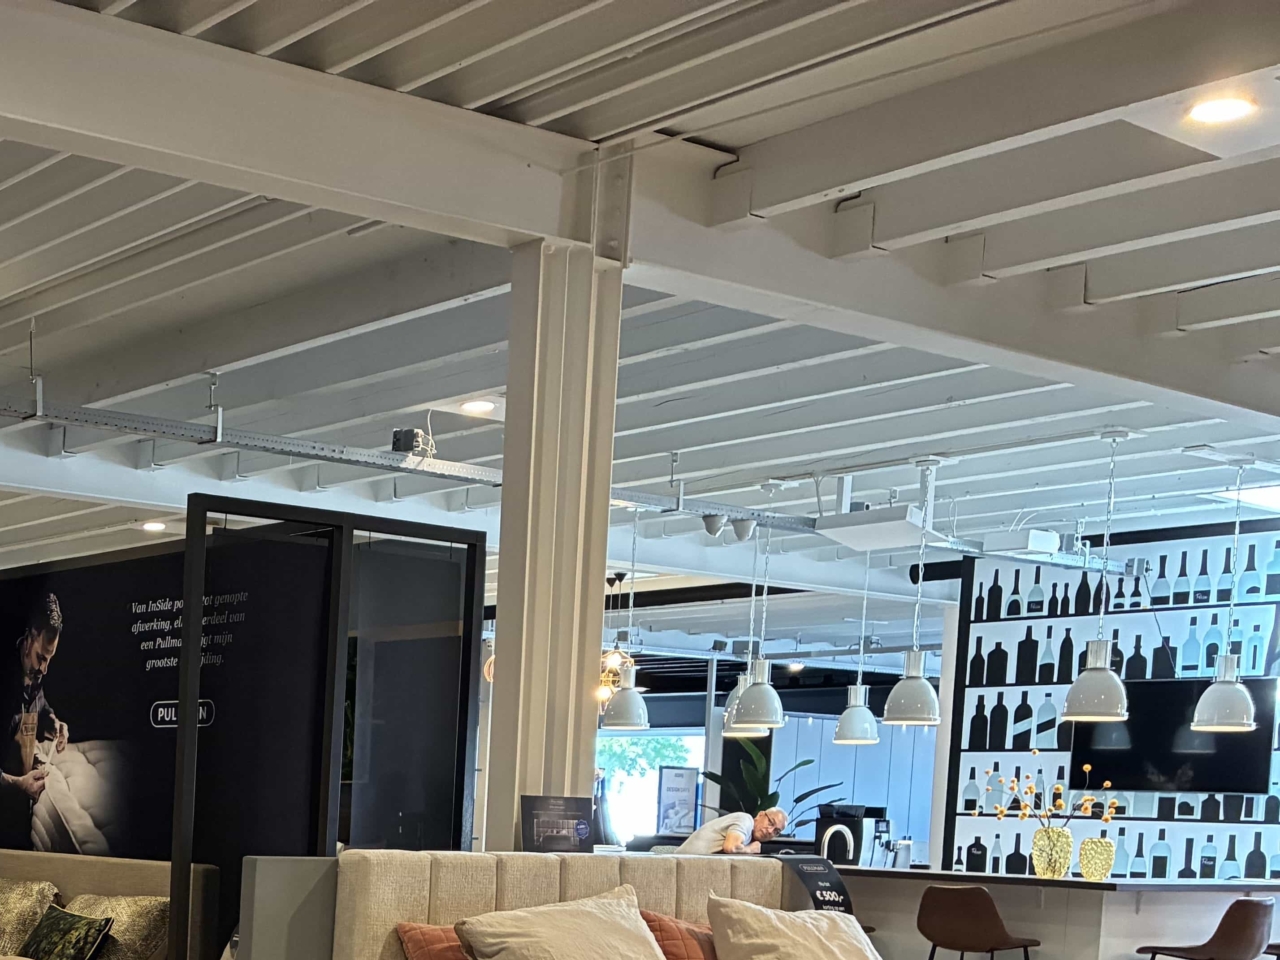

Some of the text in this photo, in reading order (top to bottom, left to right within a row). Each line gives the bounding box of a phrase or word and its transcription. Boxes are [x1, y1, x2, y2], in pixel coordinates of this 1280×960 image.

[132, 602, 146, 614] Van
[148, 598, 172, 613] InSide
[214, 591, 248, 607] genopte
[131, 618, 173, 635] afwerking,
[202, 611, 228, 625] erdeel
[229, 612, 245, 623] van
[140, 640, 153, 650] een
[155, 636, 183, 649] Pullma
[213, 632, 233, 646] mijn
[146, 656, 178, 671] grootste
[157, 706, 207, 721] PULN
